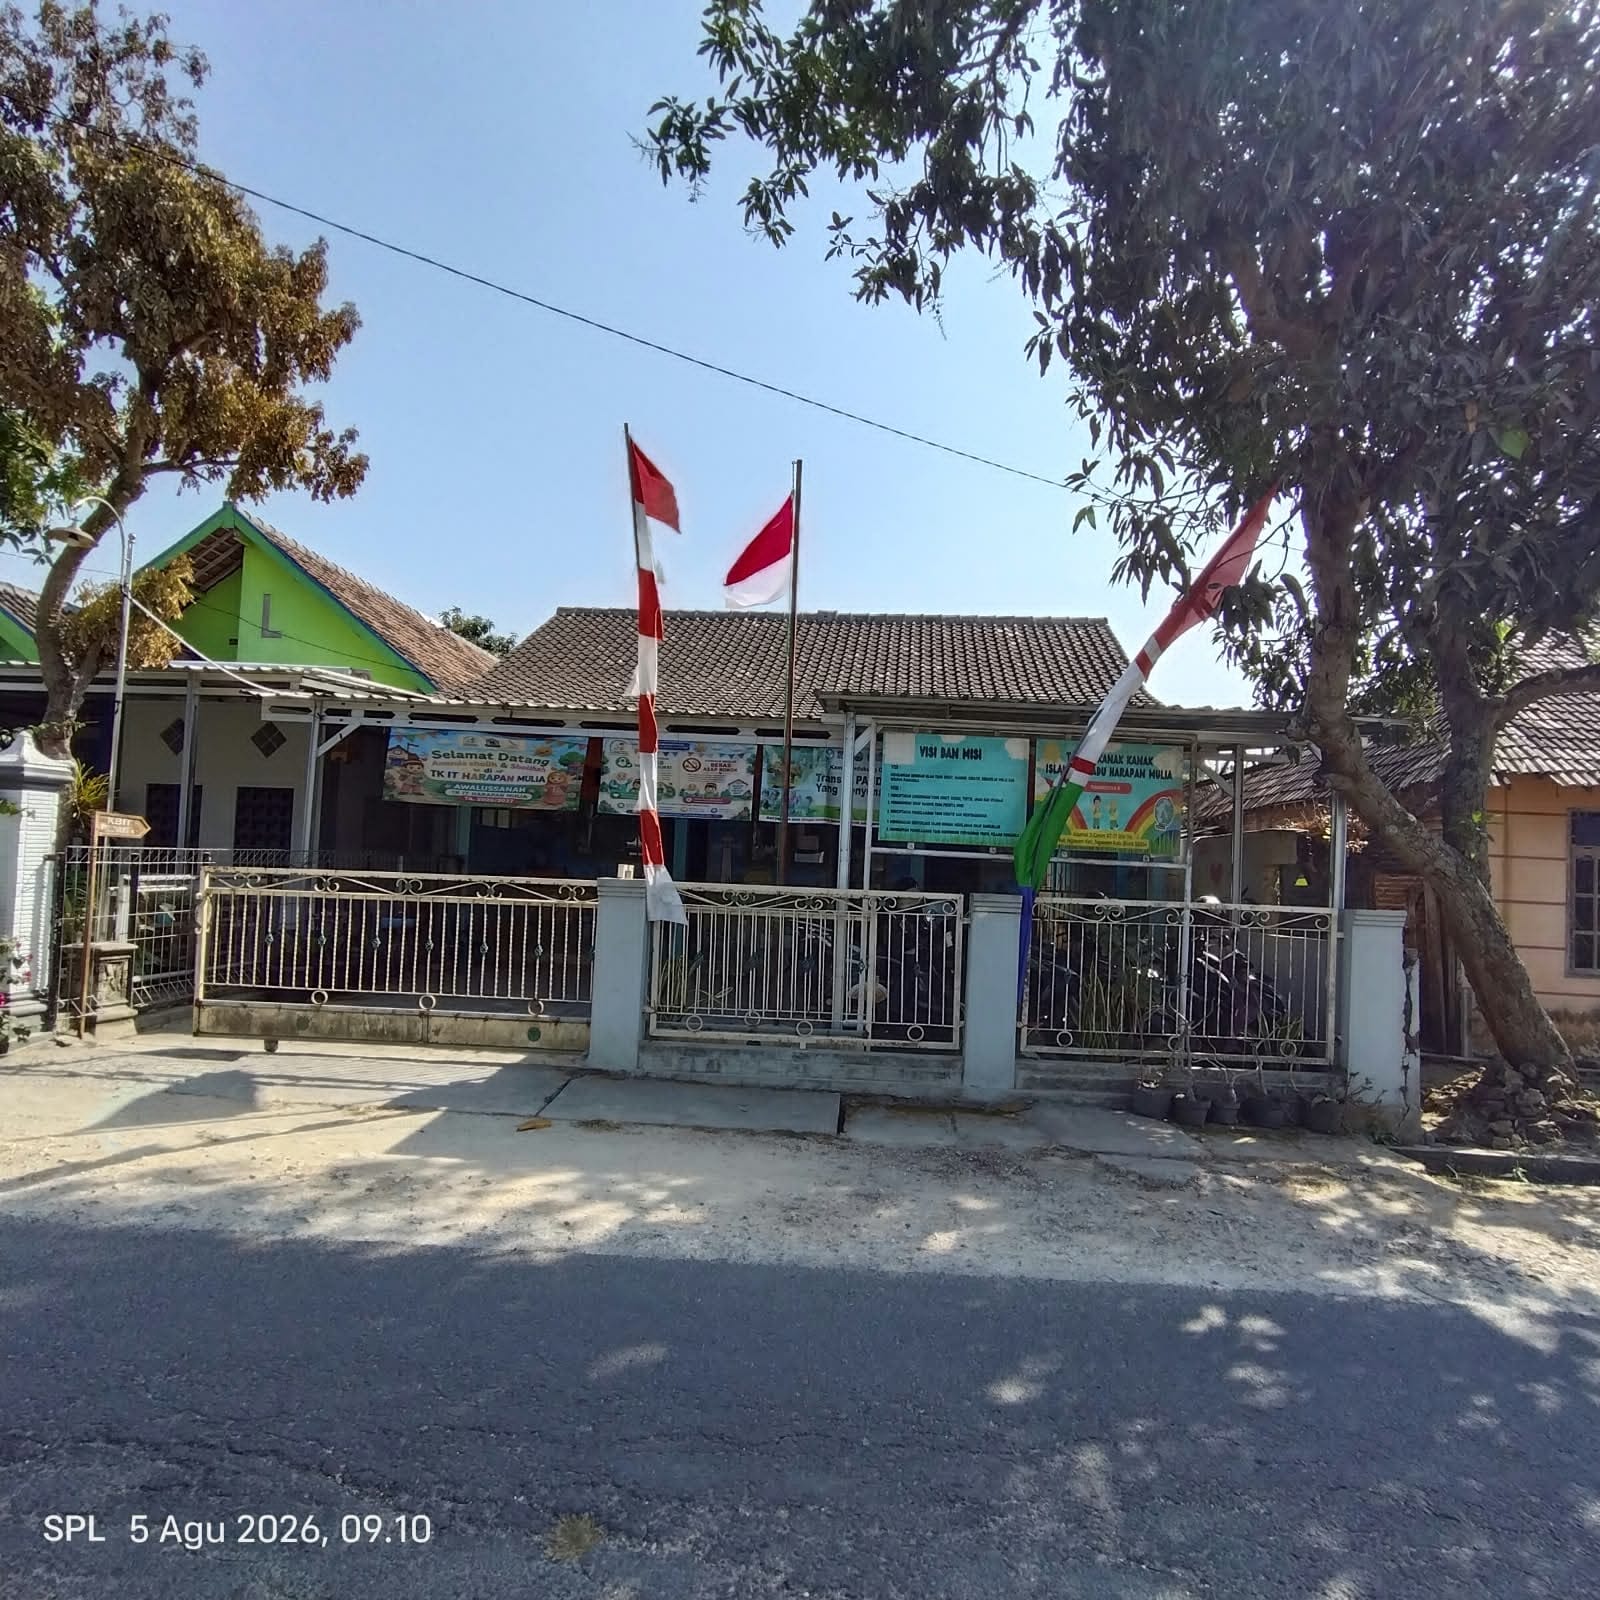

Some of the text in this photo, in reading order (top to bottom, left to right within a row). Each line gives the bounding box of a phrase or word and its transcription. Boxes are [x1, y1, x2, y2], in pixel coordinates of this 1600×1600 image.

[431, 750, 550, 767] Selamat Datang
[919, 745, 982, 761] VISI DAN MISI
[1097, 753, 1154, 766] KANAK KANAK
[430, 770, 546, 783] TK IT HARAPAN MULIA
[816, 773, 842, 784] Trans
[1109, 767, 1146, 779] HARAPAN
[1148, 769, 1173, 780] MULIA
[856, 775, 881, 786] PAD
[816, 783, 838, 796] Yang
